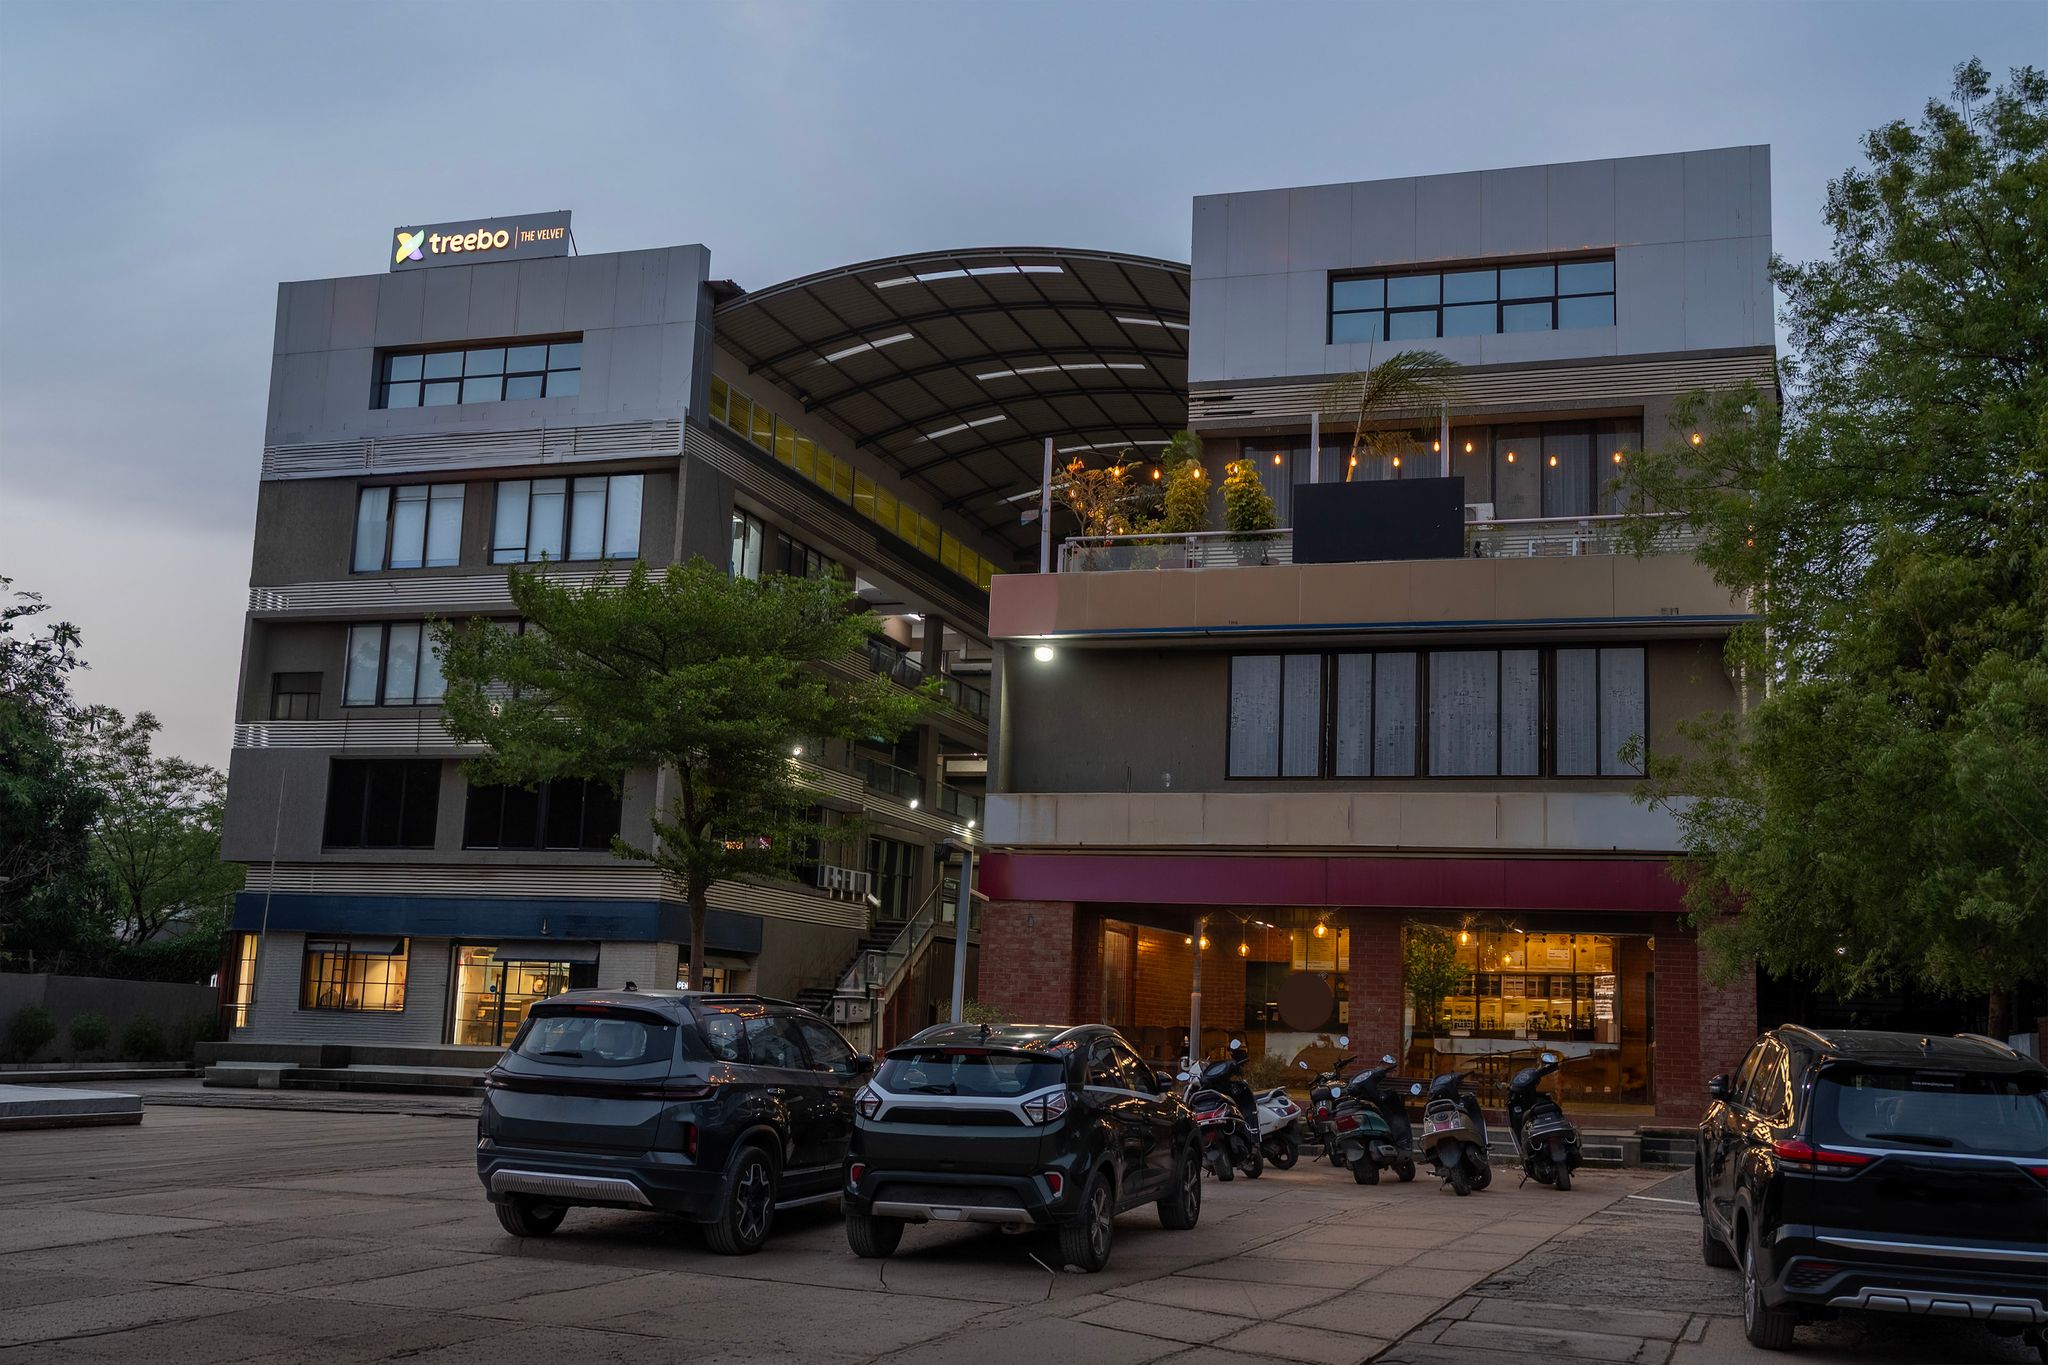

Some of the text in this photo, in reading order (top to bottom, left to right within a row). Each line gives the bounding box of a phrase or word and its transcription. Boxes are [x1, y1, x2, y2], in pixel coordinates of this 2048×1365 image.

[429, 227, 565, 254] treebo THE VELVET
